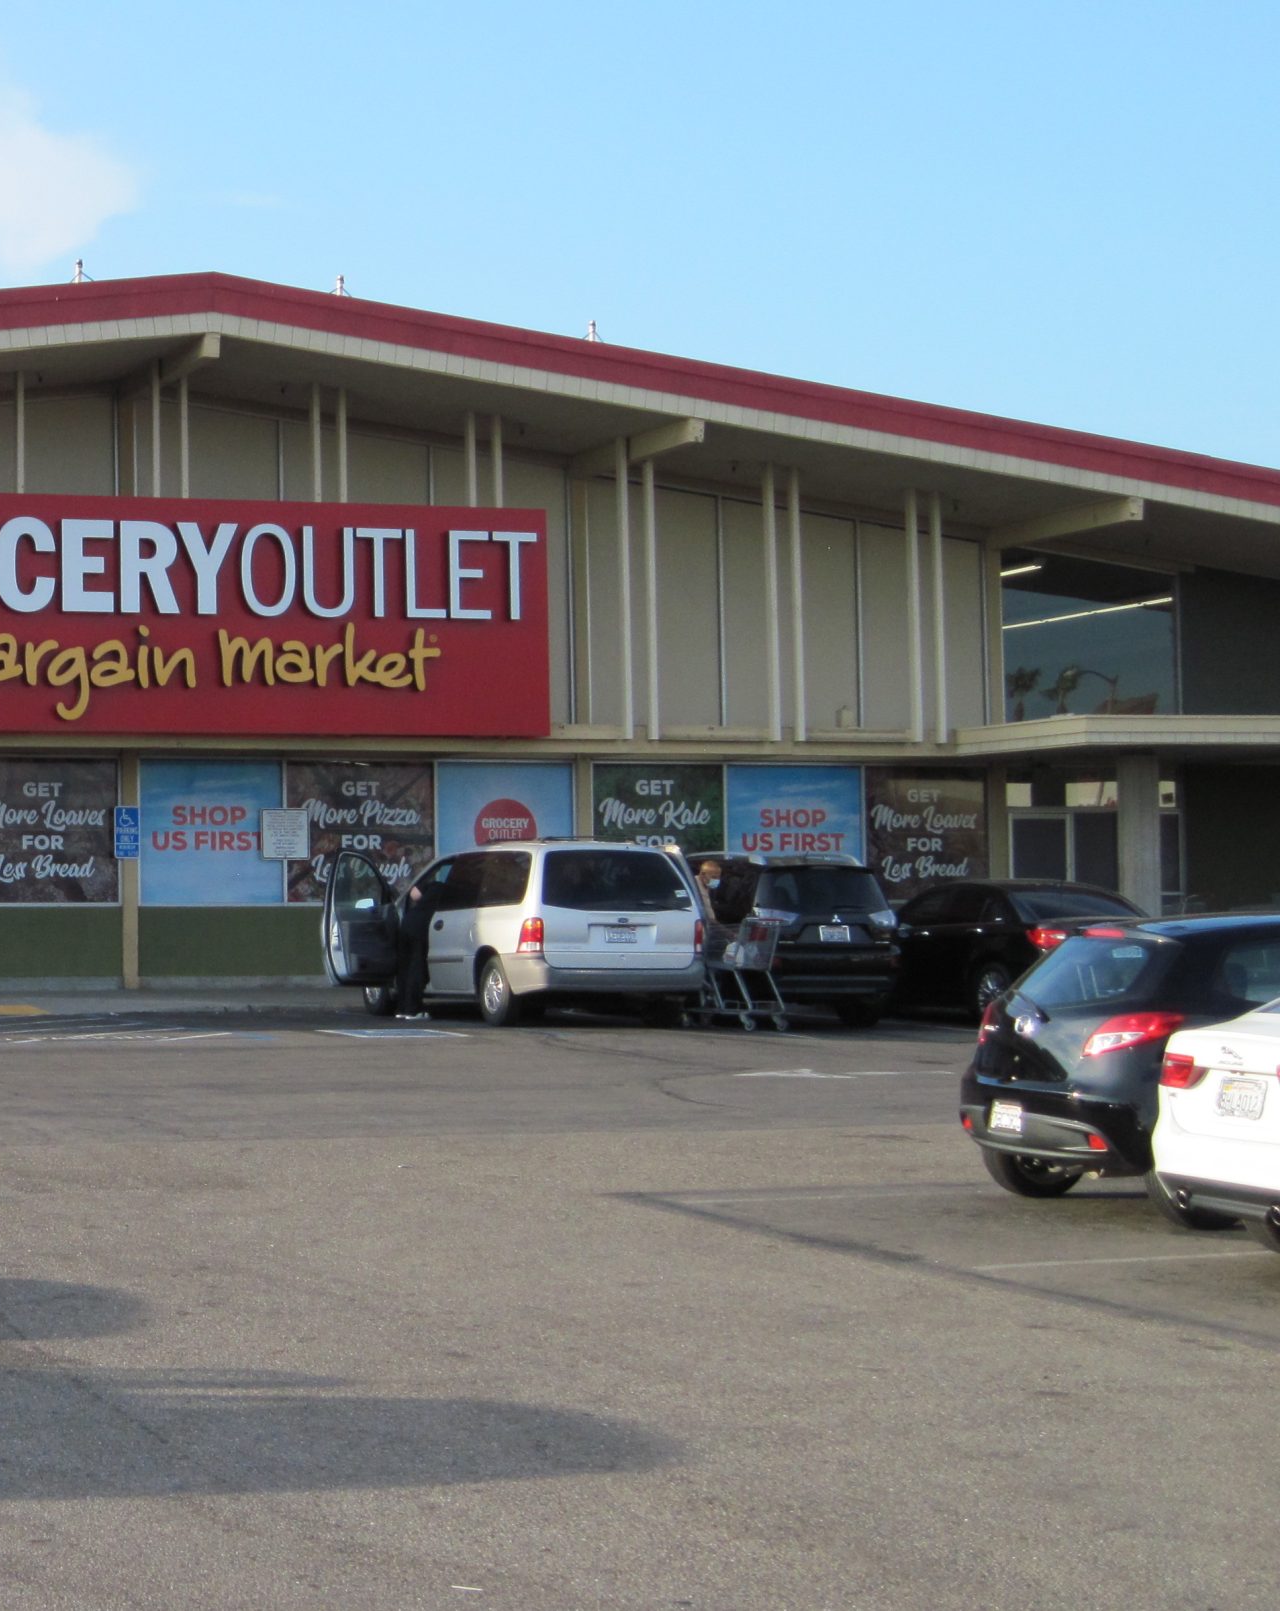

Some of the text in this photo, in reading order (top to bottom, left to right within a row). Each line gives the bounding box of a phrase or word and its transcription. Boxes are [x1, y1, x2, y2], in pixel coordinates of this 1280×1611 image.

[218, 622, 442, 691] market
[22, 781, 63, 797] GET
[341, 781, 380, 797] GET
[635, 779, 675, 796] GET
[907, 788, 941, 803] GET
[41, 800, 107, 832] Loaves
[172, 805, 247, 826] SHOP
[302, 798, 421, 830] More Pizza
[481, 818, 529, 829] GROCERY
[599, 797, 712, 830] More Kale
[760, 807, 827, 829] SHOP
[870, 803, 978, 835] More Loaves
[22, 835, 64, 850] FOR
[152, 830, 188, 852] US
[194, 831, 263, 852] FIRST
[341, 834, 382, 850] FOR
[488, 828, 523, 840] OUTLET
[635, 835, 676, 848] FOR
[742, 831, 845, 853] US FIRST
[906, 837, 943, 852] FOR
[31, 854, 96, 879] Bread
[881, 855, 969, 883] Less Bread
